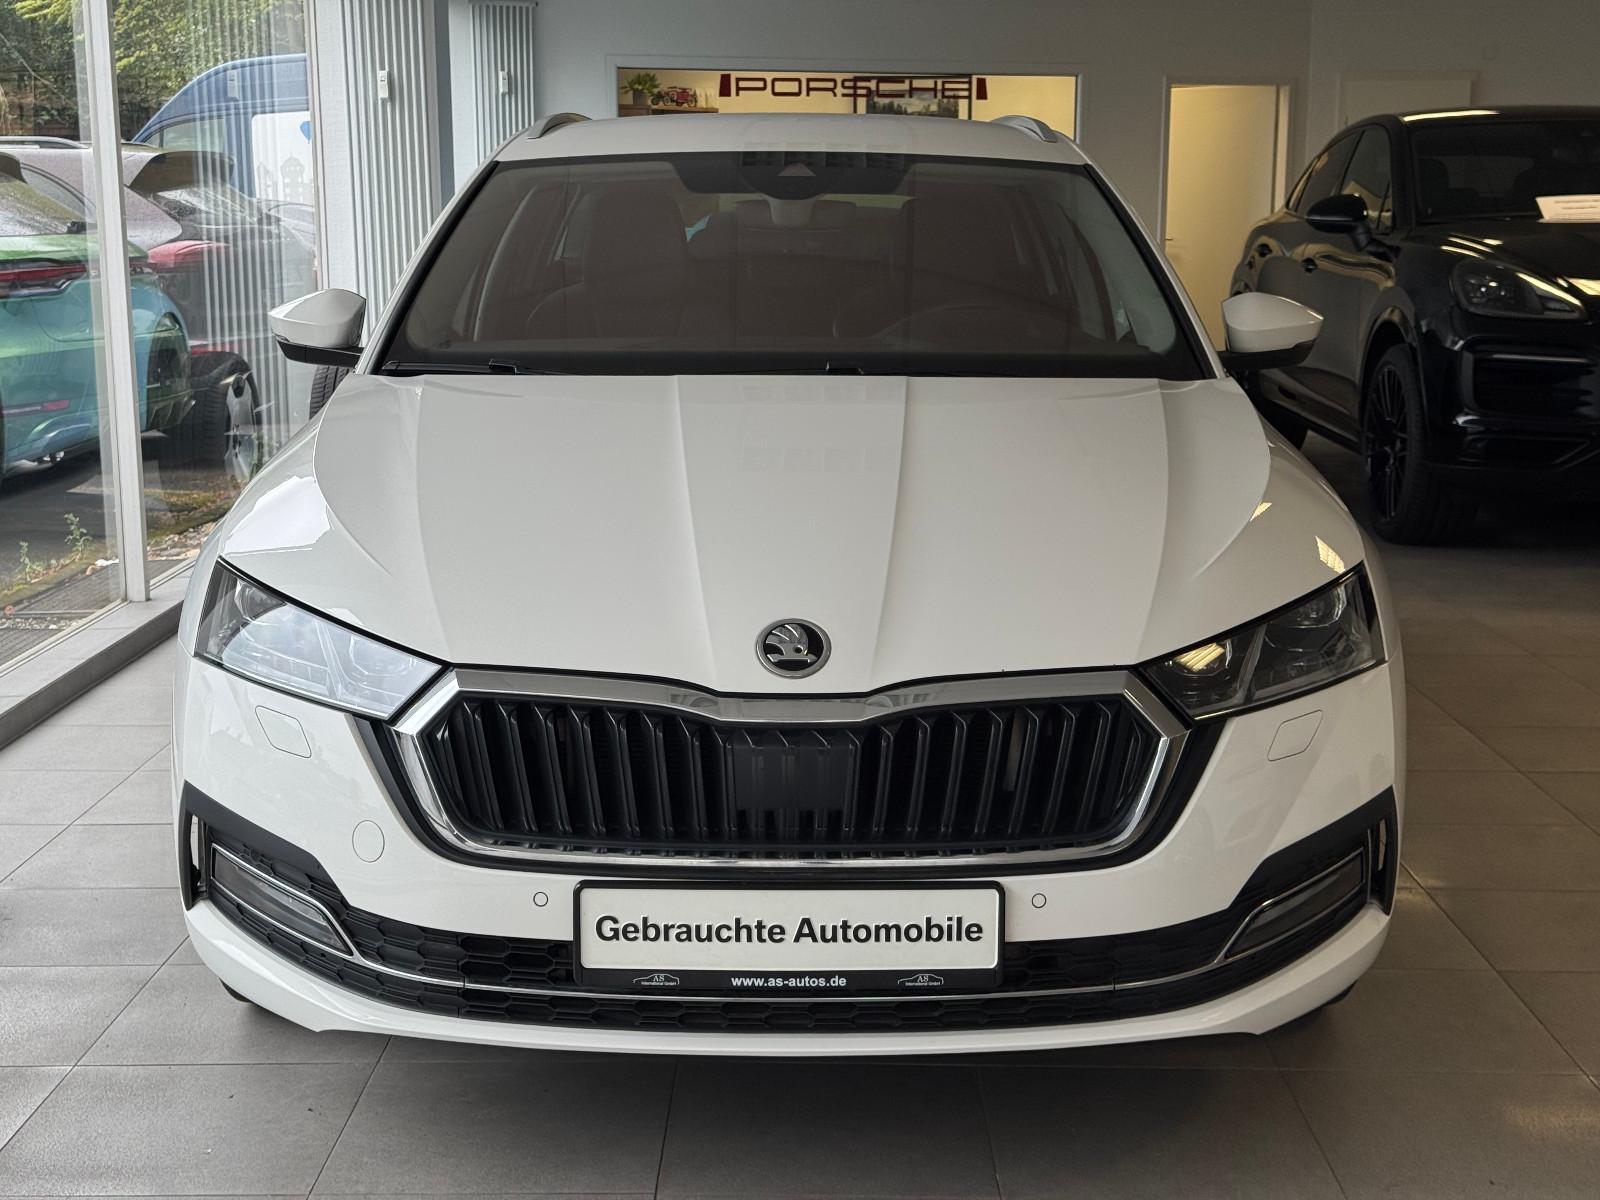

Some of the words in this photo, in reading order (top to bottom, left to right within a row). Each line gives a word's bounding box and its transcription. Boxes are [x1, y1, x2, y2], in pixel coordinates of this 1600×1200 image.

[735, 77, 971, 100] PORSCHE
[595, 915, 786, 943] Gebrauchte
[793, 915, 983, 944] Automobile
[731, 975, 847, 987] www.as-autos.de
